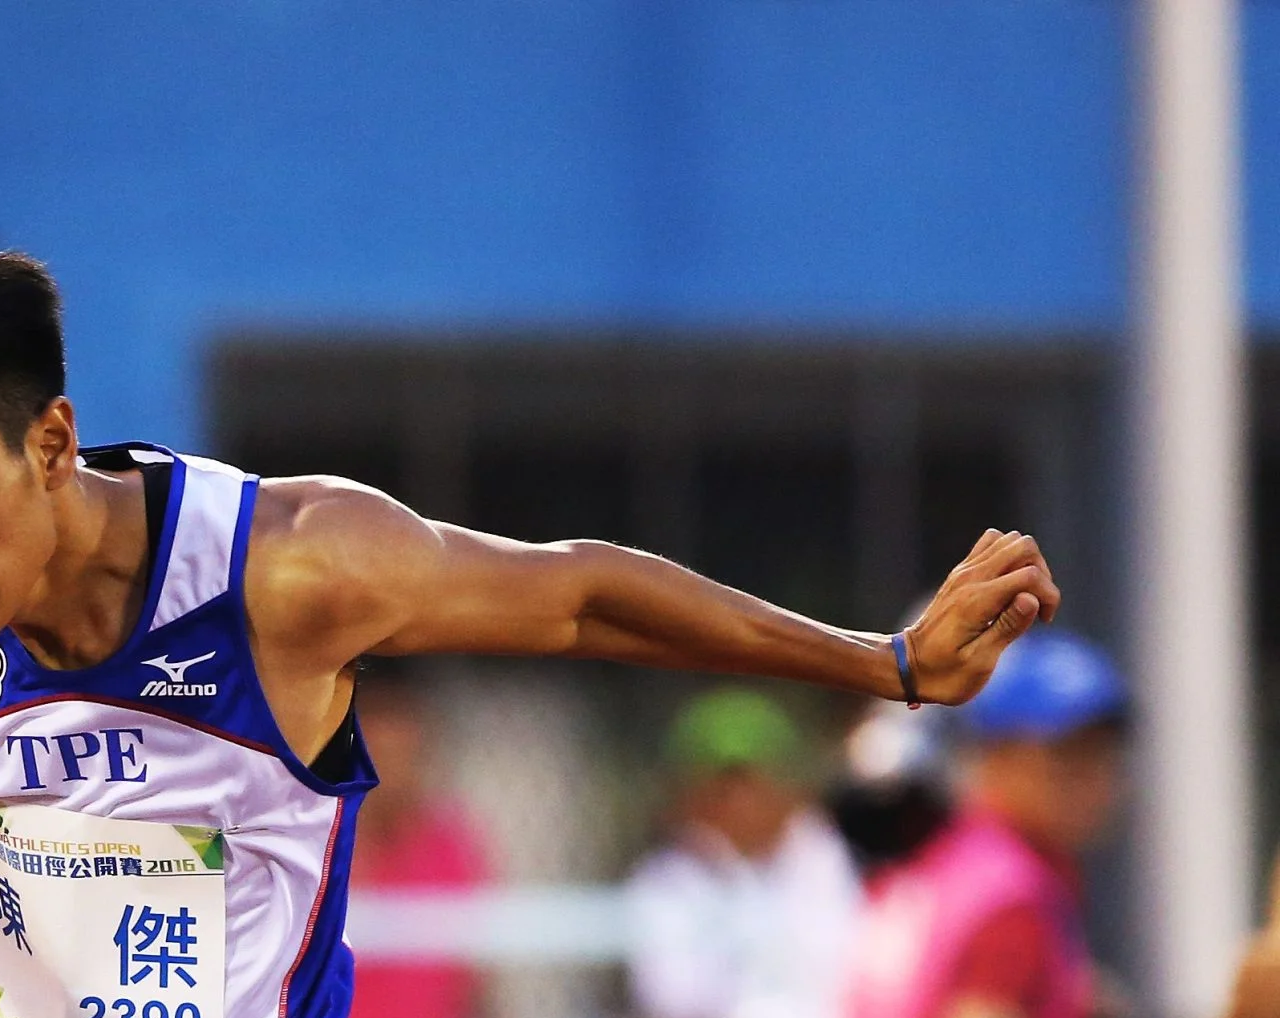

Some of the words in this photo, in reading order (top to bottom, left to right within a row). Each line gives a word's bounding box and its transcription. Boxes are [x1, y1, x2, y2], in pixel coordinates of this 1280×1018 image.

[7, 728, 148, 791] TPE
[3, 834, 90, 856] ATHLETICS
[94, 842, 142, 856] OPEN
[146, 858, 196, 873] 2016
[113, 904, 198, 989] 傑
